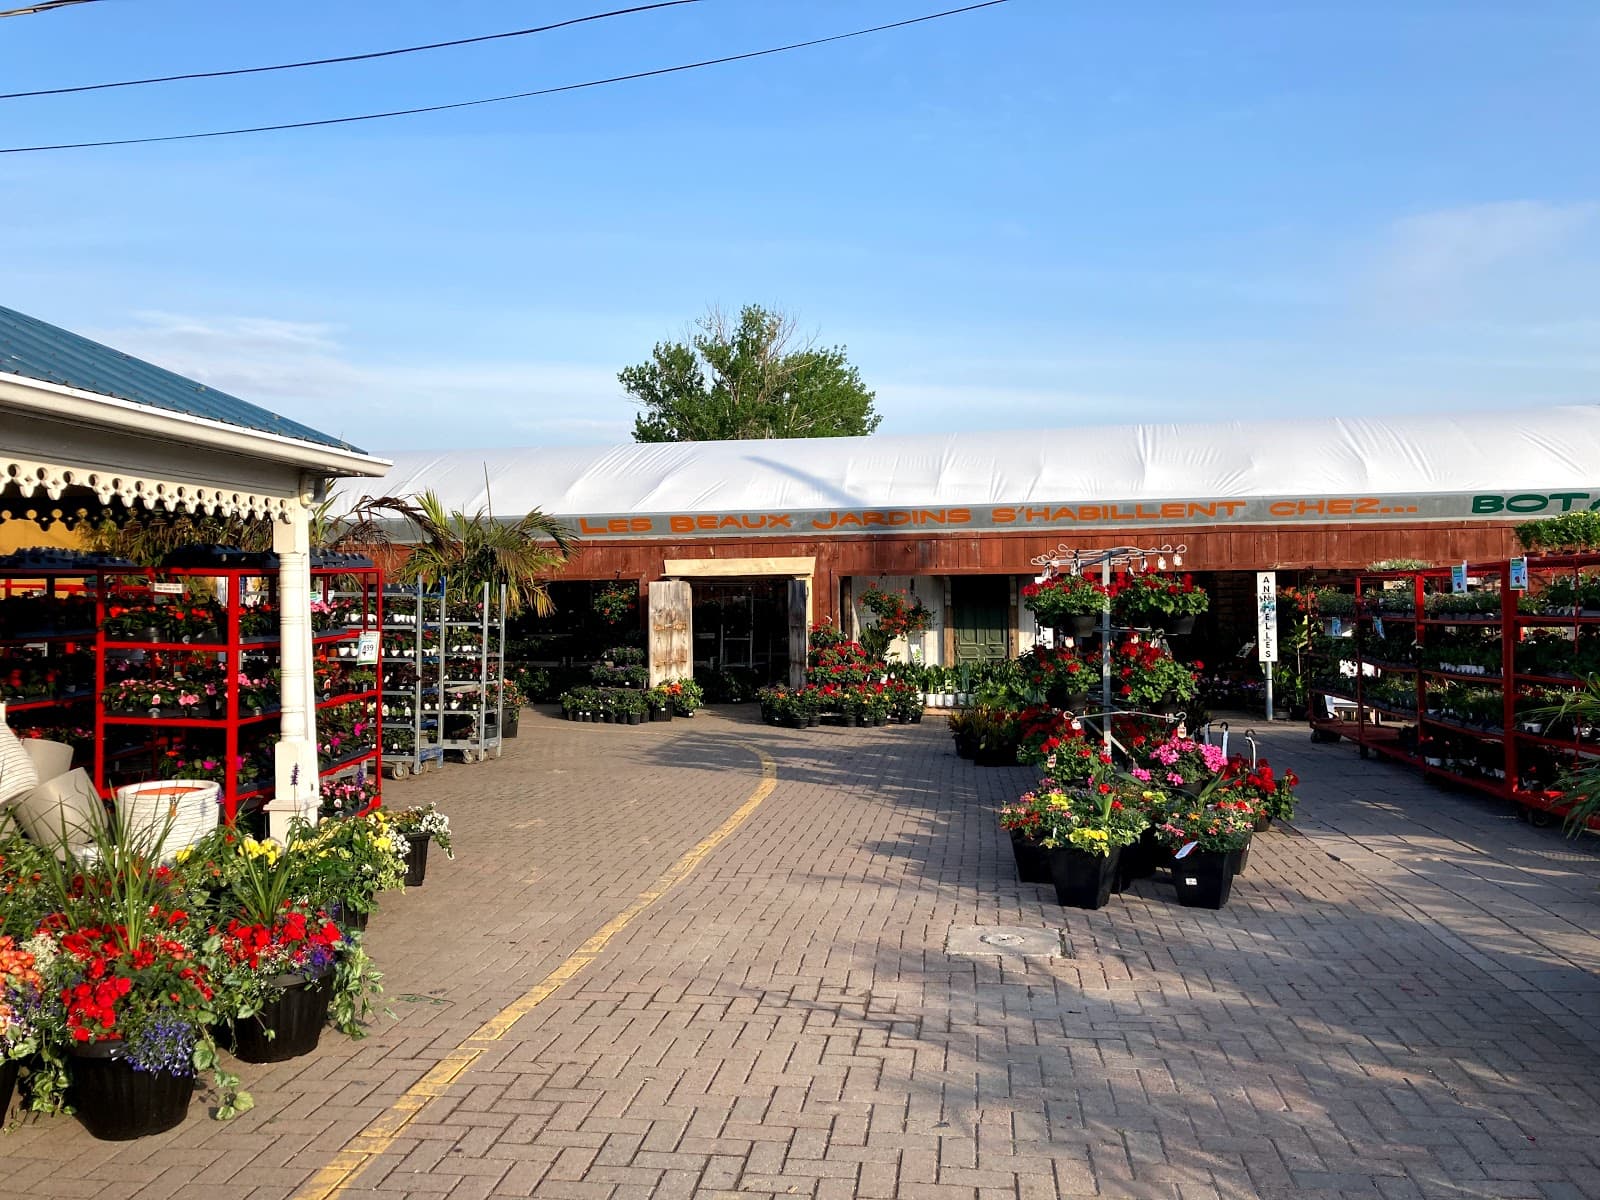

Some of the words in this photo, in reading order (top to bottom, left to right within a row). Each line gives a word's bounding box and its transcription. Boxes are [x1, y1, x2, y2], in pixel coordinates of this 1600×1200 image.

[579, 516, 653, 534] LES
[670, 513, 792, 533] BEAUX
[811, 508, 972, 530] JARDINS
[991, 500, 1247, 523] S'HABILLENT
